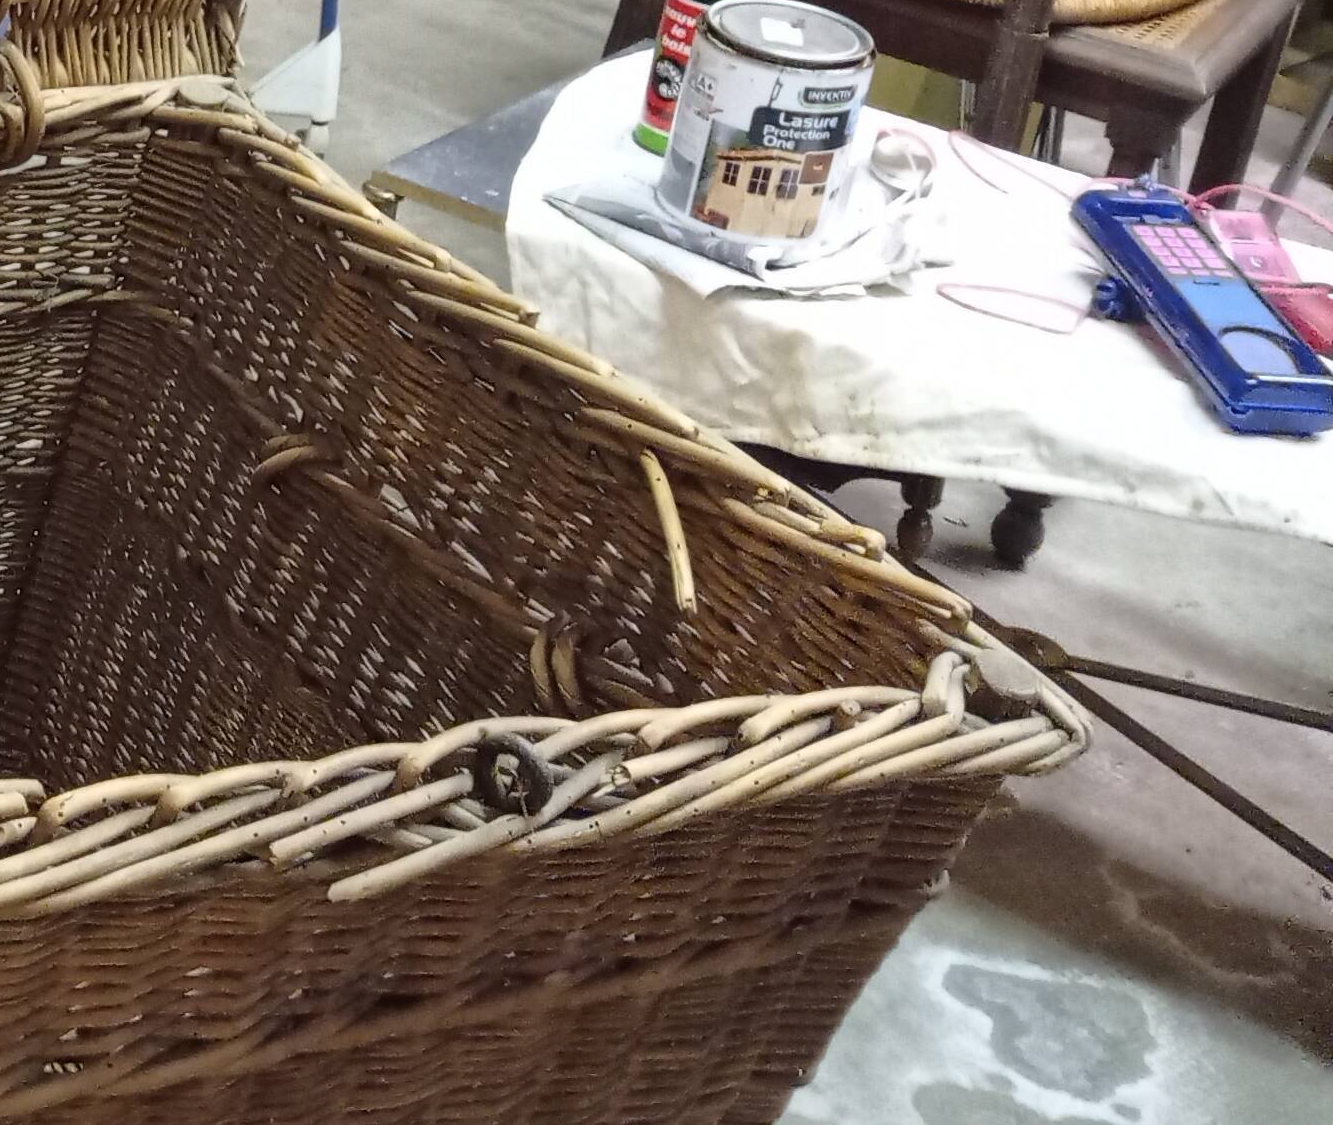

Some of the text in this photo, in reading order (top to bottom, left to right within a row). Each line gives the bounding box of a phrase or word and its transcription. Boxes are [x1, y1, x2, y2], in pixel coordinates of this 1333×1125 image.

[778, 111, 839, 130] Lasure
[763, 124, 831, 141] Protection
[763, 134, 797, 151] One
